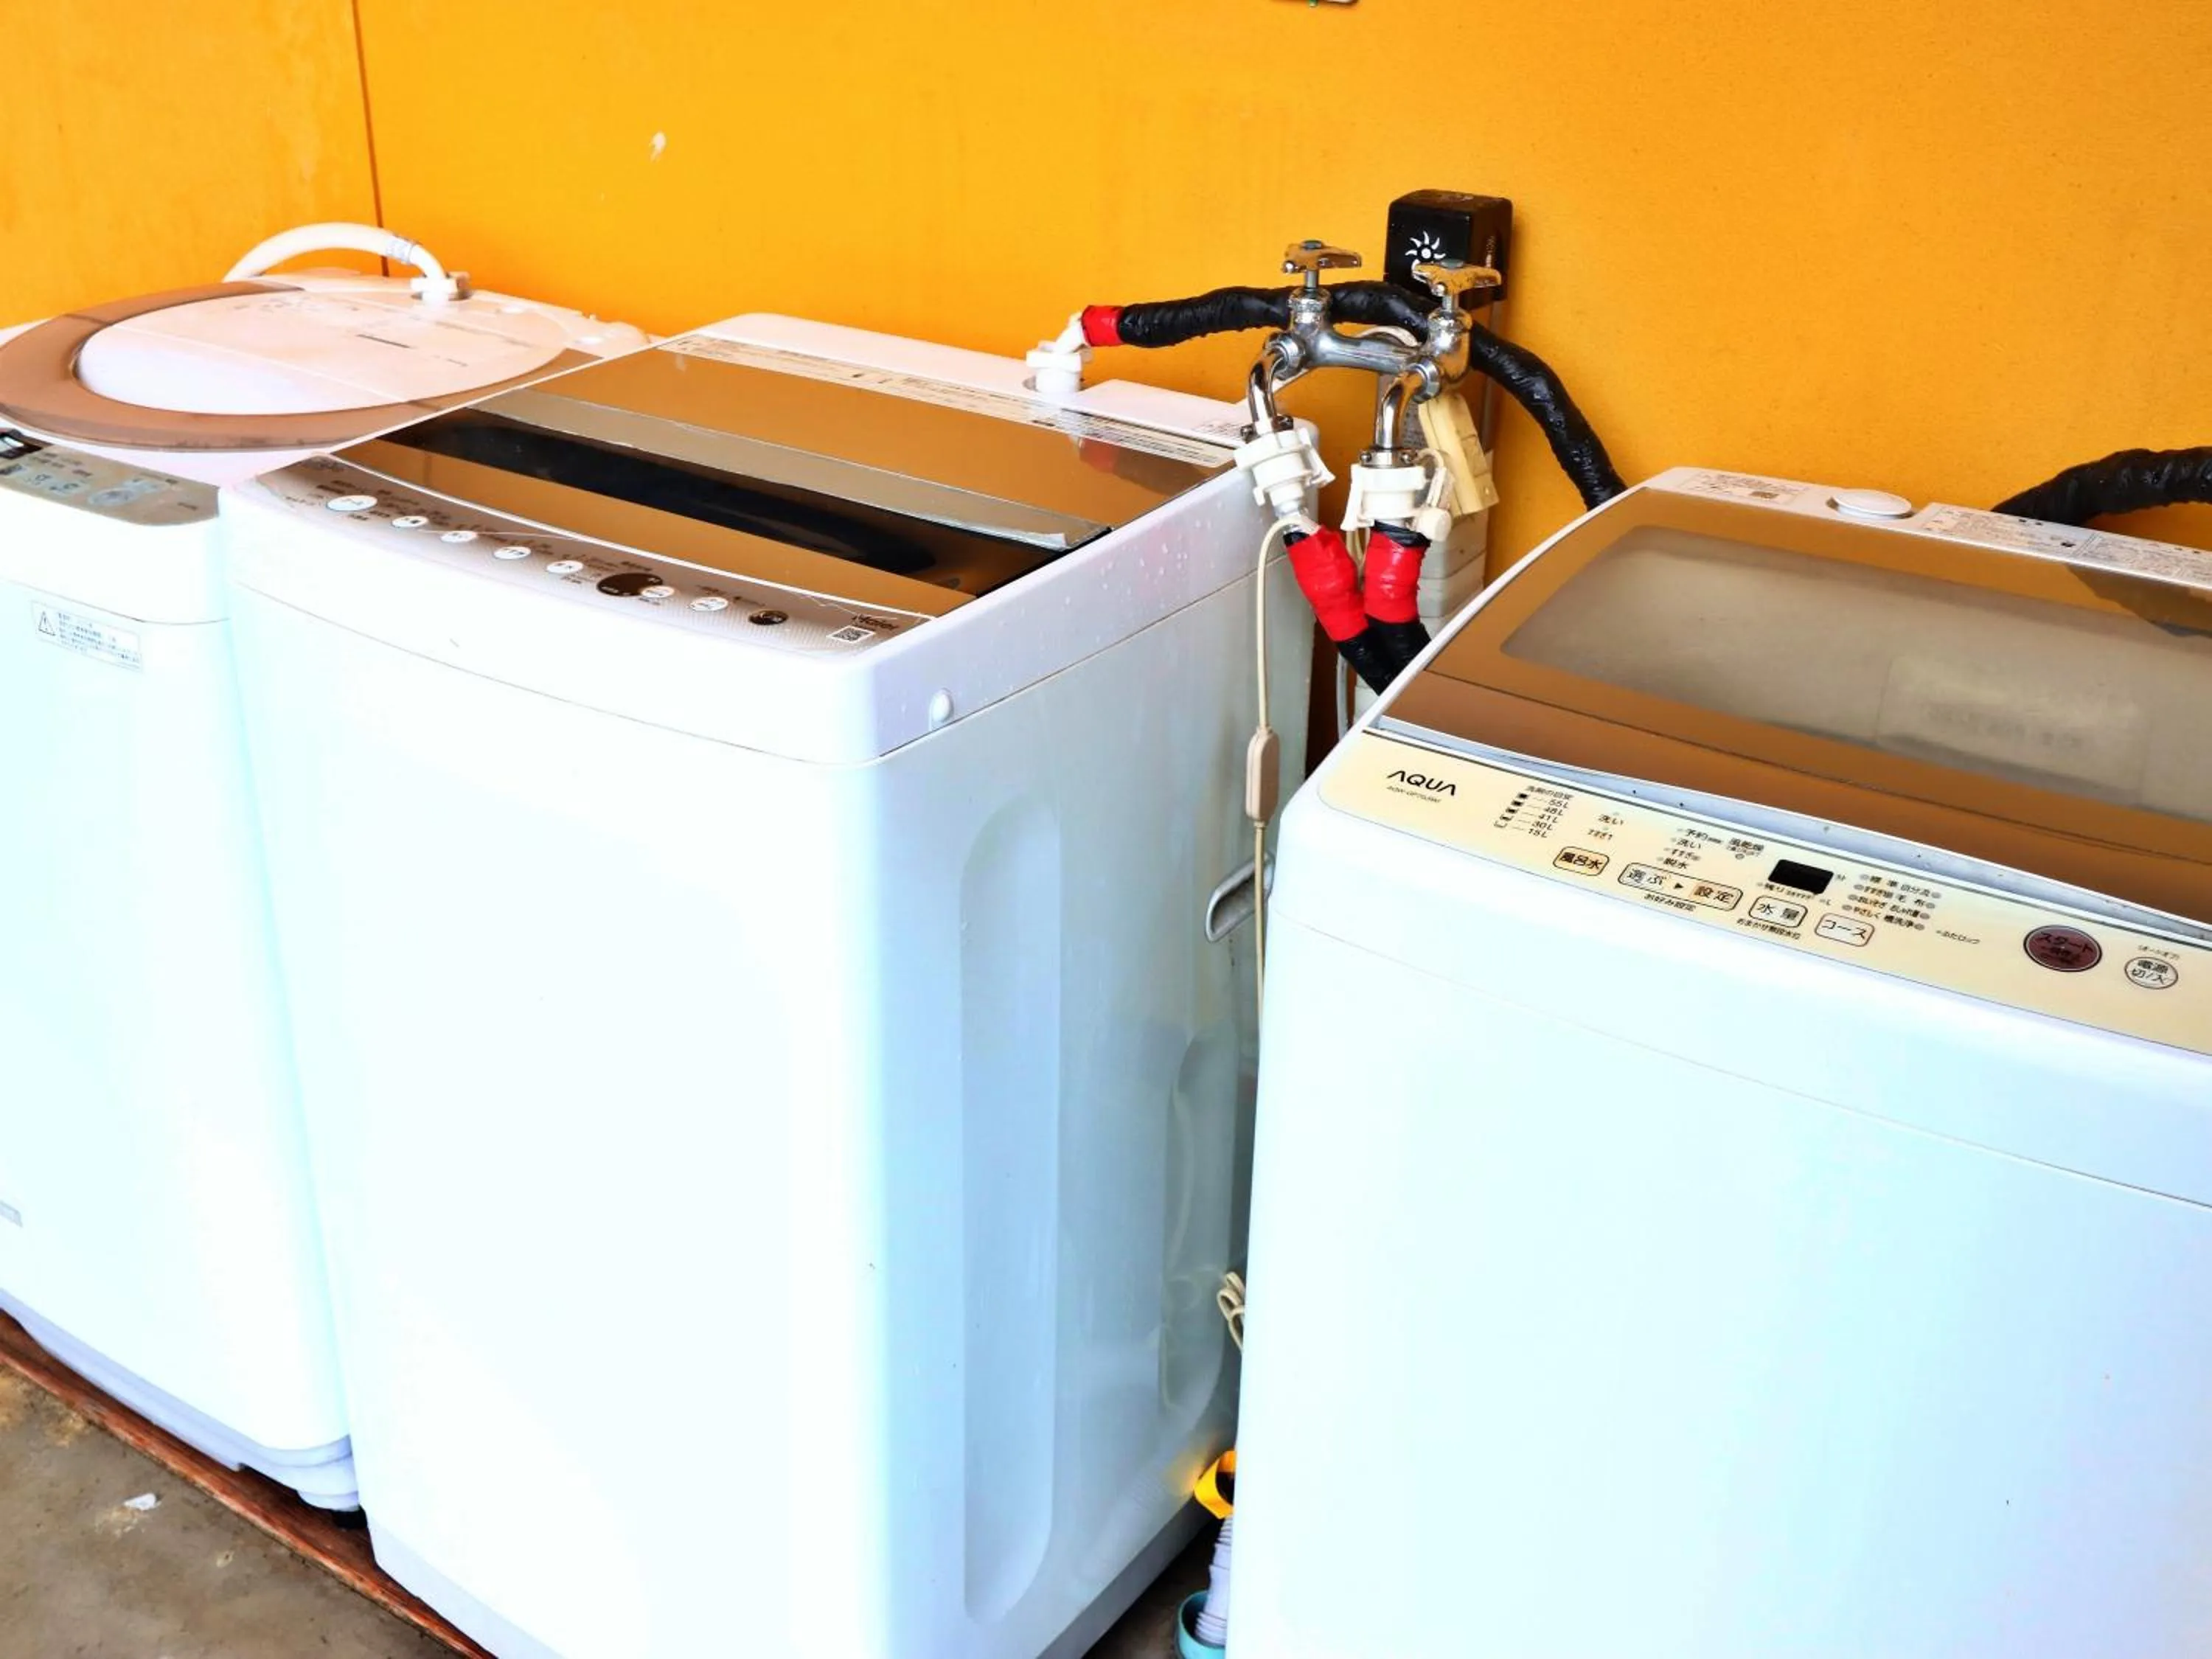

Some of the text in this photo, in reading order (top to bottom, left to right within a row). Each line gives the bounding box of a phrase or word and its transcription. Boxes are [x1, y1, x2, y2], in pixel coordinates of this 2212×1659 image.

[1387, 770, 1456, 796] AQUA
[1559, 852, 1604, 869] 風呂水
[1627, 868, 1667, 886] 選ぶ
[1693, 885, 1734, 903] 設定
[1756, 903, 1800, 921] 水量
[1821, 919, 1867, 940] コース
[2039, 931, 2094, 953] スタート
[2138, 959, 2168, 974] 電源
